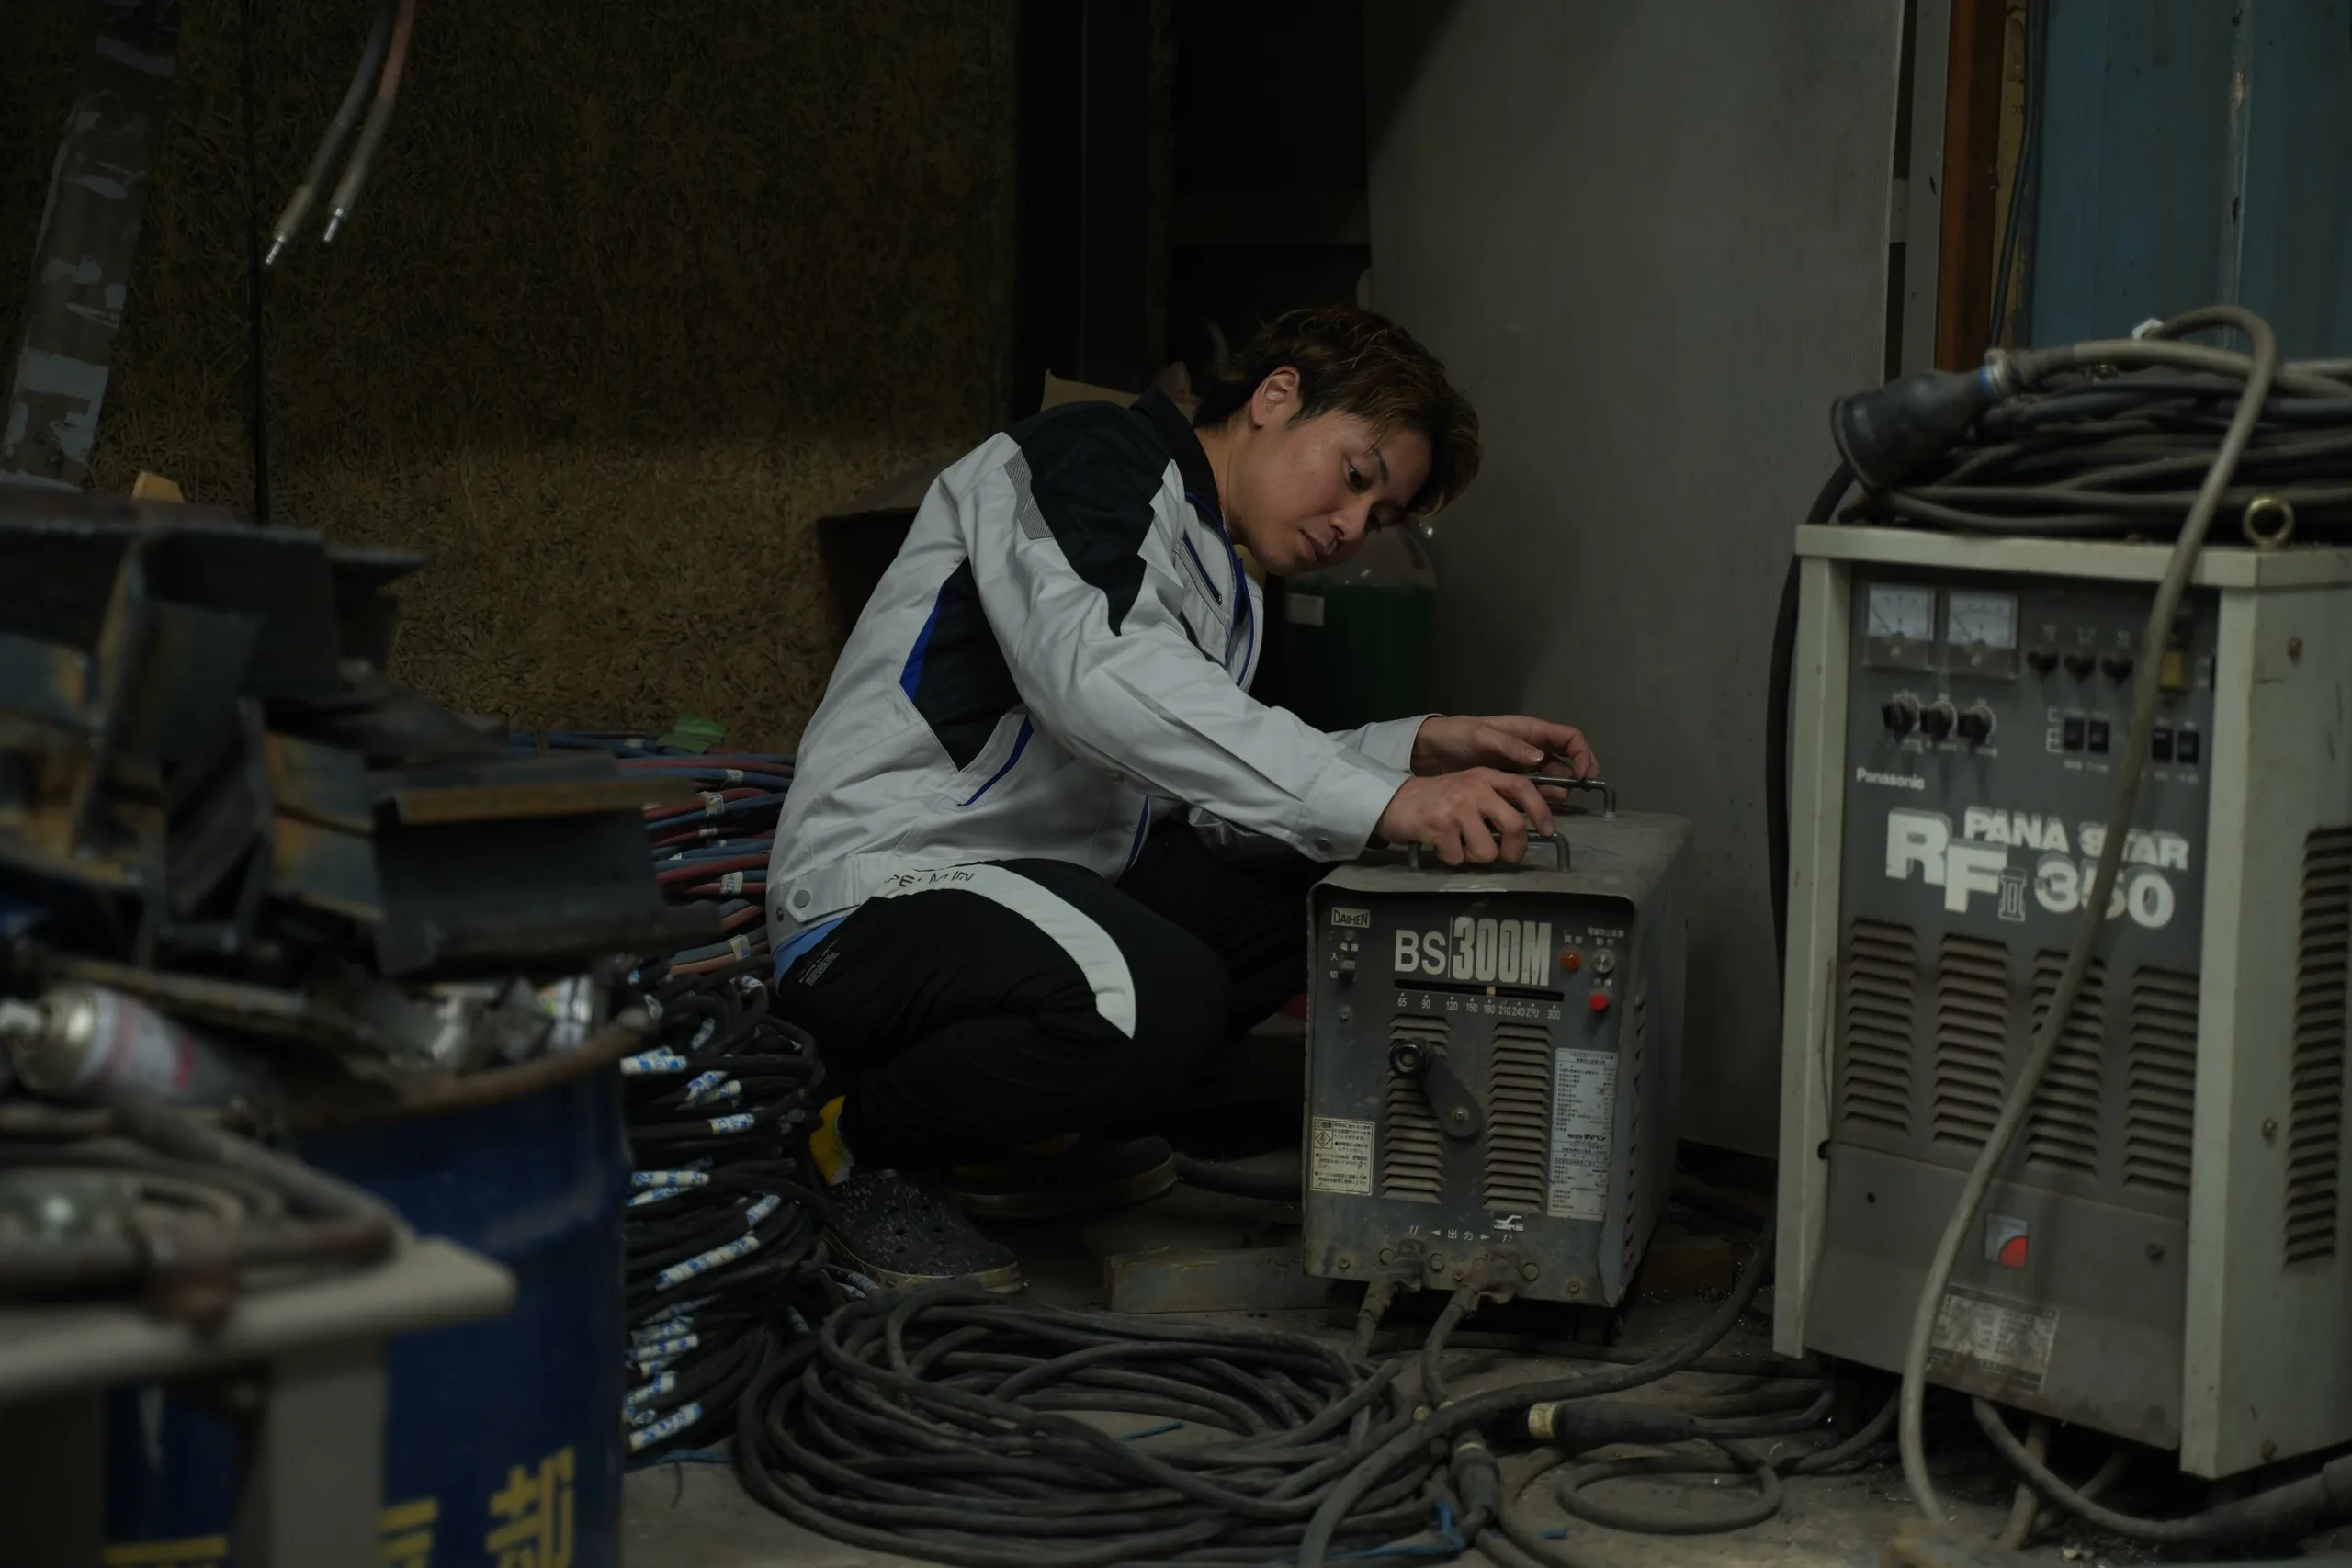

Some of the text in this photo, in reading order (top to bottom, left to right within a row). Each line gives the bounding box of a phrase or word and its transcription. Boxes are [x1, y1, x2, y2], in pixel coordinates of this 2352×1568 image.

[1856, 766, 1925, 790] Panasonic
[1964, 805, 2070, 854] PANA
[1885, 806, 2009, 913] RF
[1332, 909, 1368, 926] DAIHEN
[1452, 916, 1552, 987] 300M
[1397, 998, 1561, 1020] 65 90 120 150 180 210 240 270 300
[1447, 1229, 1474, 1241] 出力
